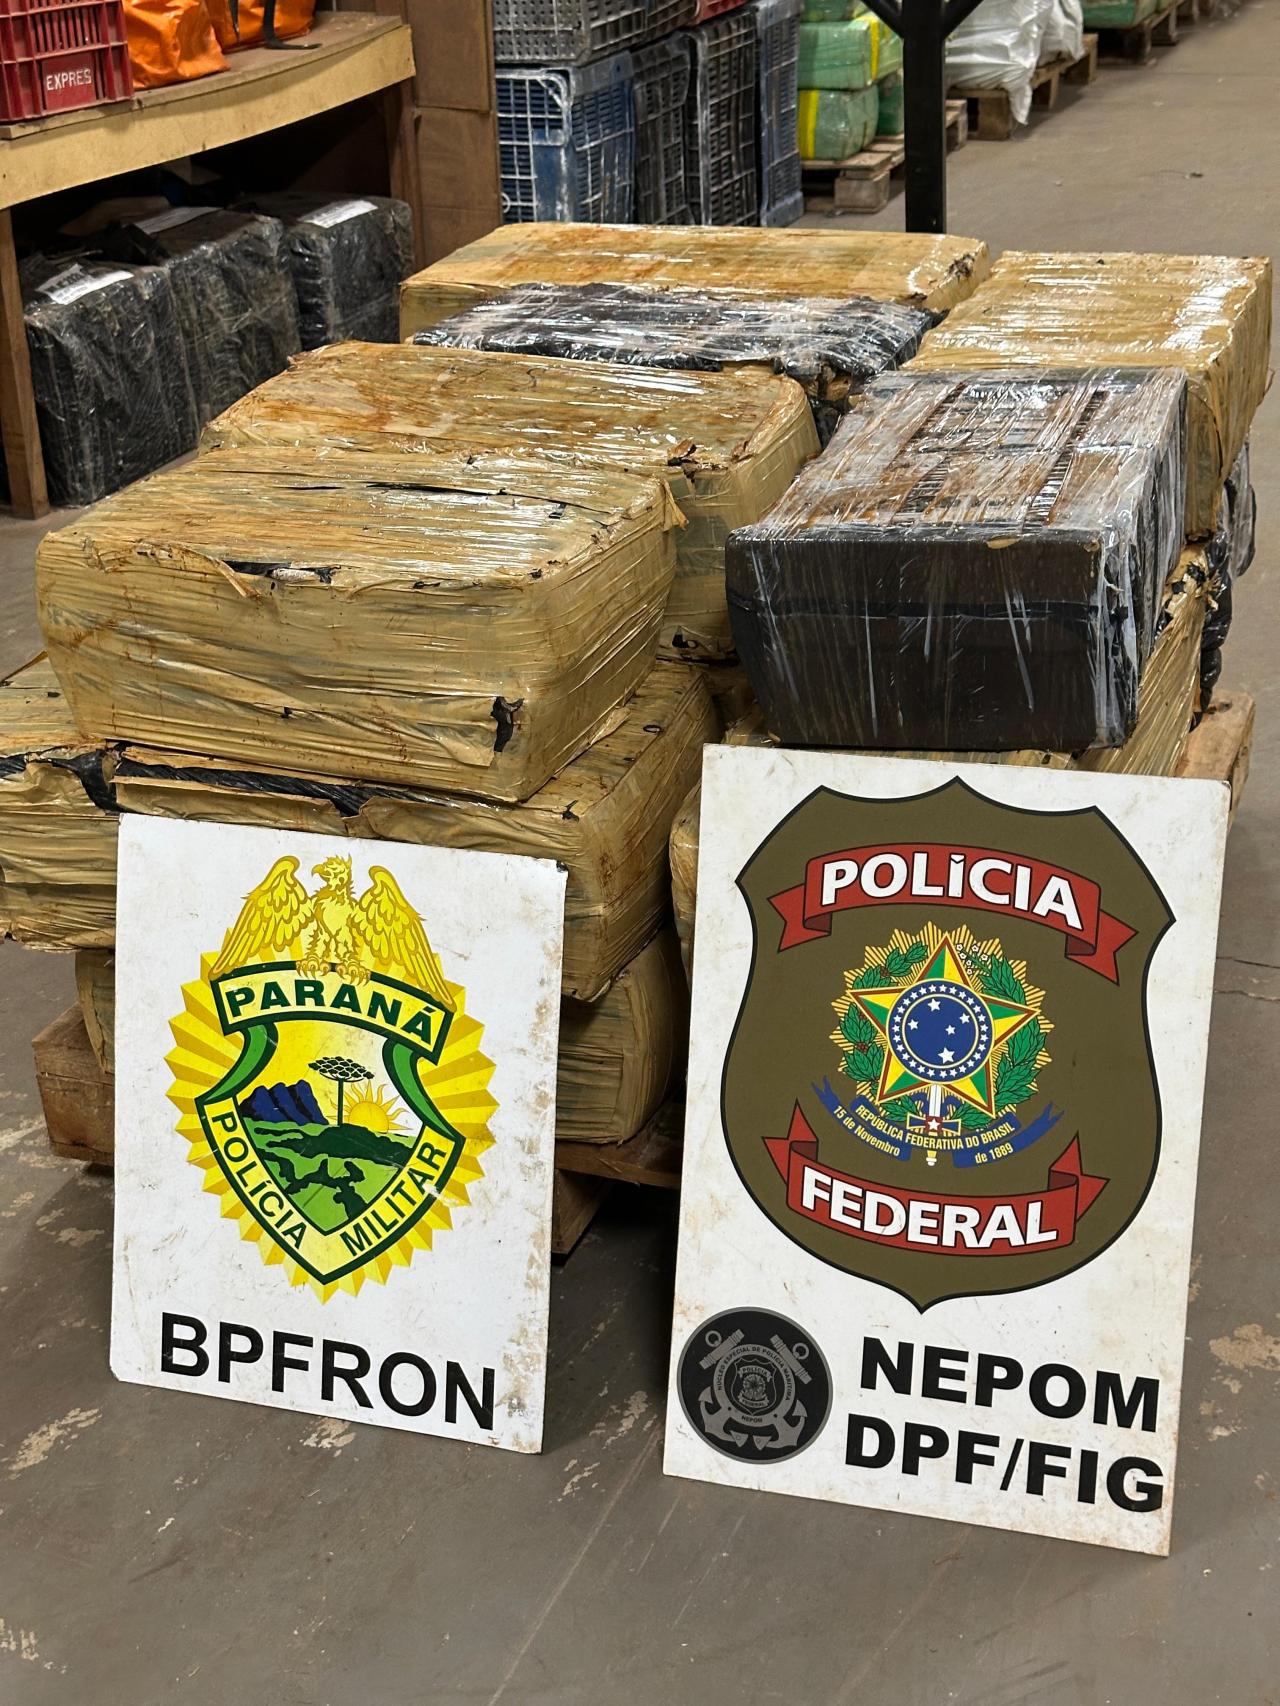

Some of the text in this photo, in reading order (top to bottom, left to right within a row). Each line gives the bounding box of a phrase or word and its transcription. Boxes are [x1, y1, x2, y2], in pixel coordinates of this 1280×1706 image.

[46, 69, 92, 91] EXPRES
[821, 852, 1083, 930] POLÍCIA
[225, 979, 434, 1045] PARANÁ
[833, 1105, 901, 1157] 15 de Novembro
[905, 1132, 964, 1151] FEDERATIVA
[965, 1134, 981, 1149] DO
[981, 1121, 1015, 1145] BRASIL
[974, 1142, 1014, 1165] de 1889
[211, 1112, 447, 1257] POLÍCIA MILITAR
[802, 1165, 1058, 1248] FEDERAL
[161, 1312, 495, 1431] BPFRON
[860, 1336, 1160, 1433] NEPOM
[845, 1413, 1164, 1513] DPF/FIG
